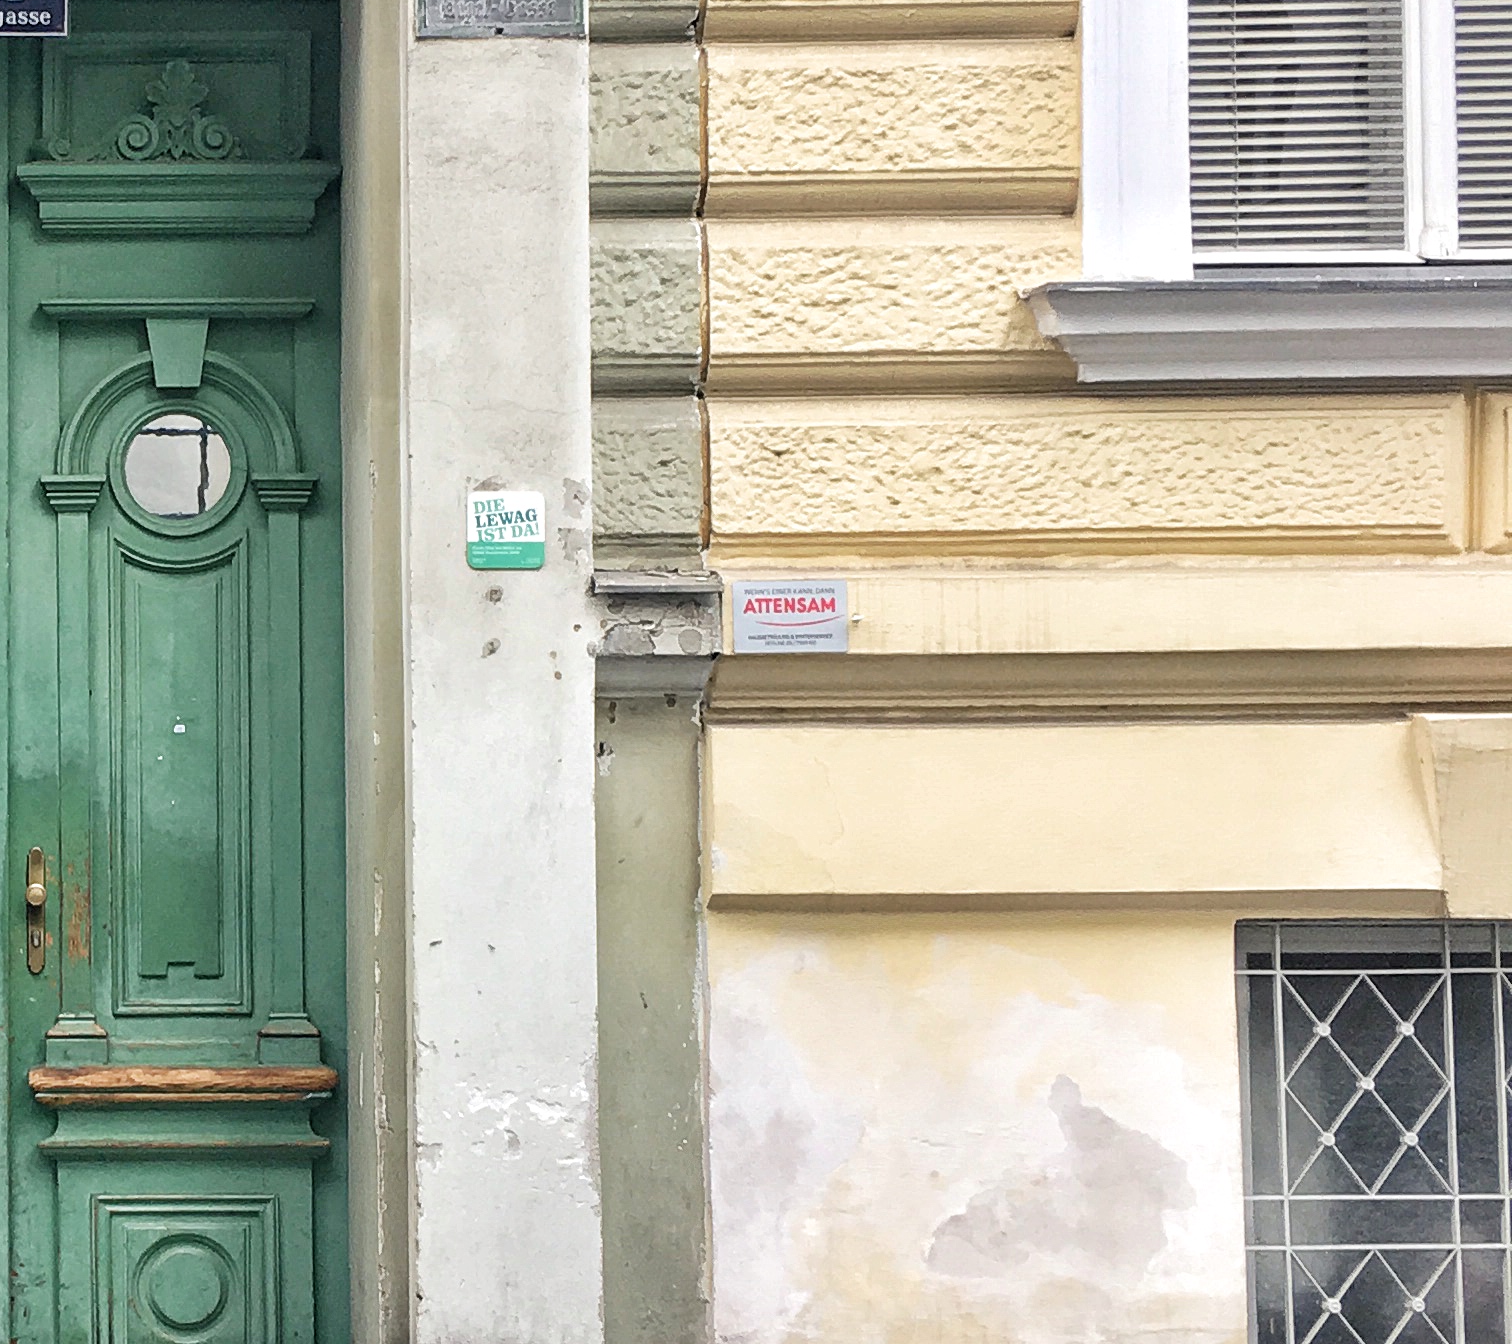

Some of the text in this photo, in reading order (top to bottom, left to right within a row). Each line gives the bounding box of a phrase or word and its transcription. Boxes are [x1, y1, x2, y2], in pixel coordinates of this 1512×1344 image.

[473, 498, 505, 514] DIE
[475, 509, 537, 528] LEWAG
[476, 522, 539, 542] IST DA!
[743, 597, 836, 614] ATTENSAM
